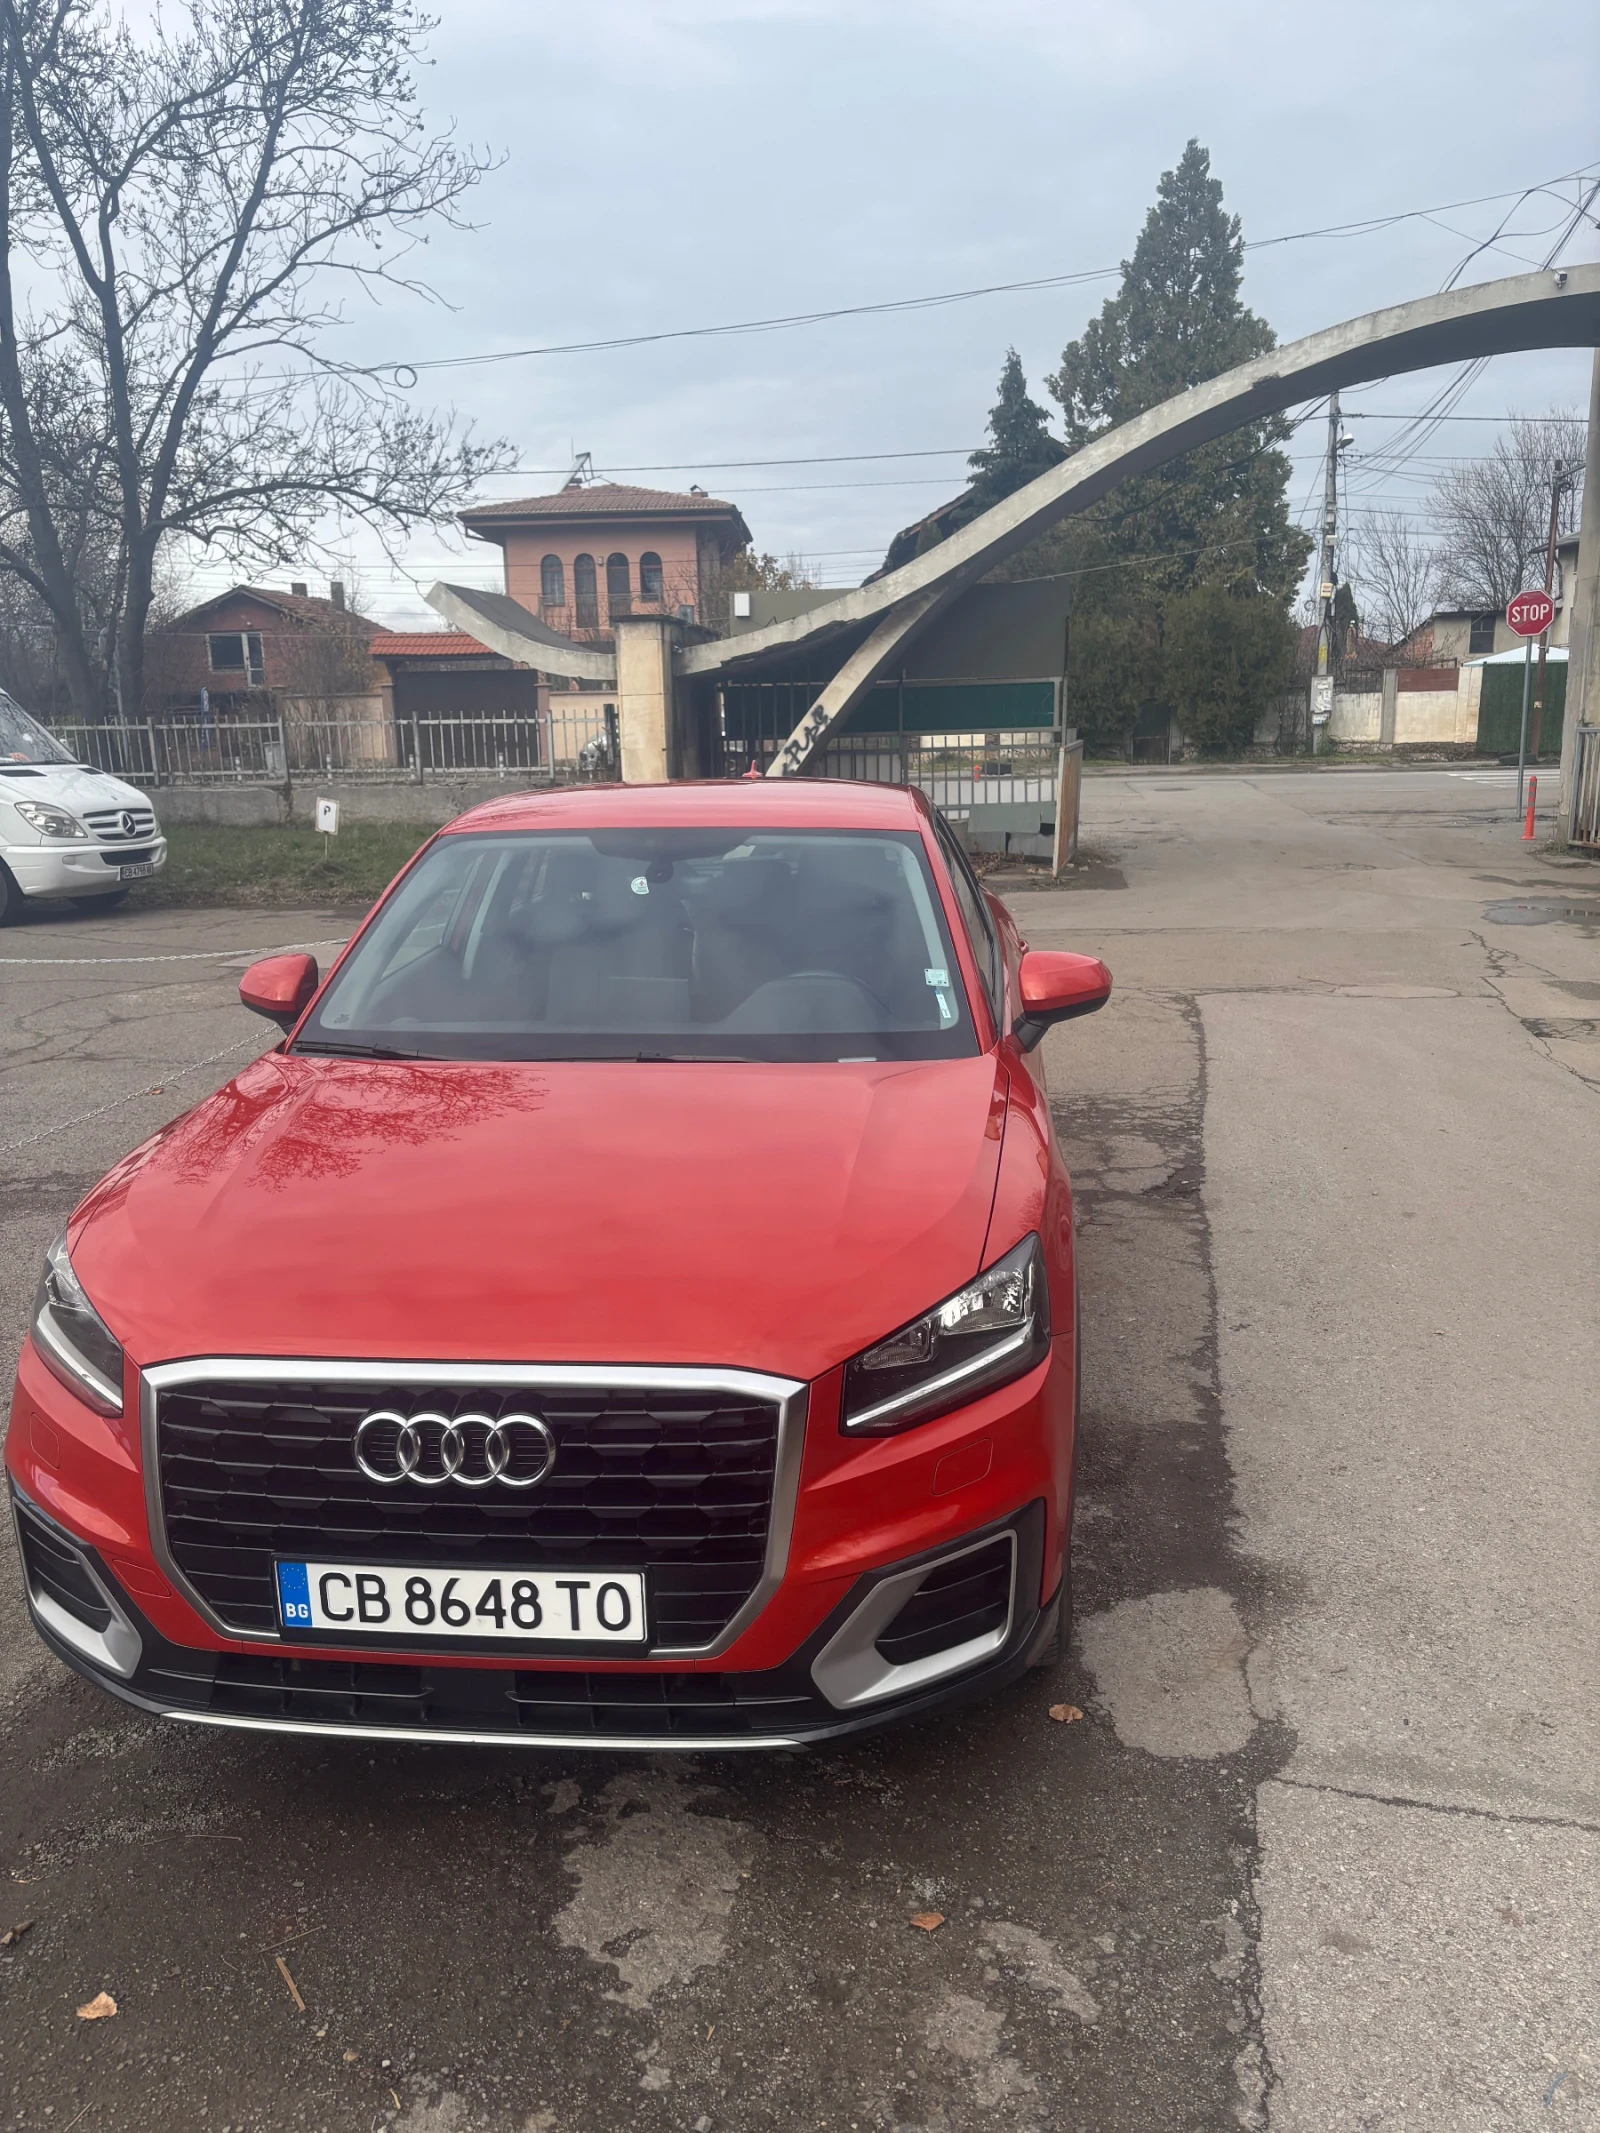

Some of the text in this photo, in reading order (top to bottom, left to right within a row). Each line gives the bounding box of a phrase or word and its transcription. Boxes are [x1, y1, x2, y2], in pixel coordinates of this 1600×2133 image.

[1511, 603, 1550, 623] STOP
[323, 805, 331, 816] P
[285, 1603, 309, 1618] BG
[319, 1572, 631, 1632] CB 8648 TO
